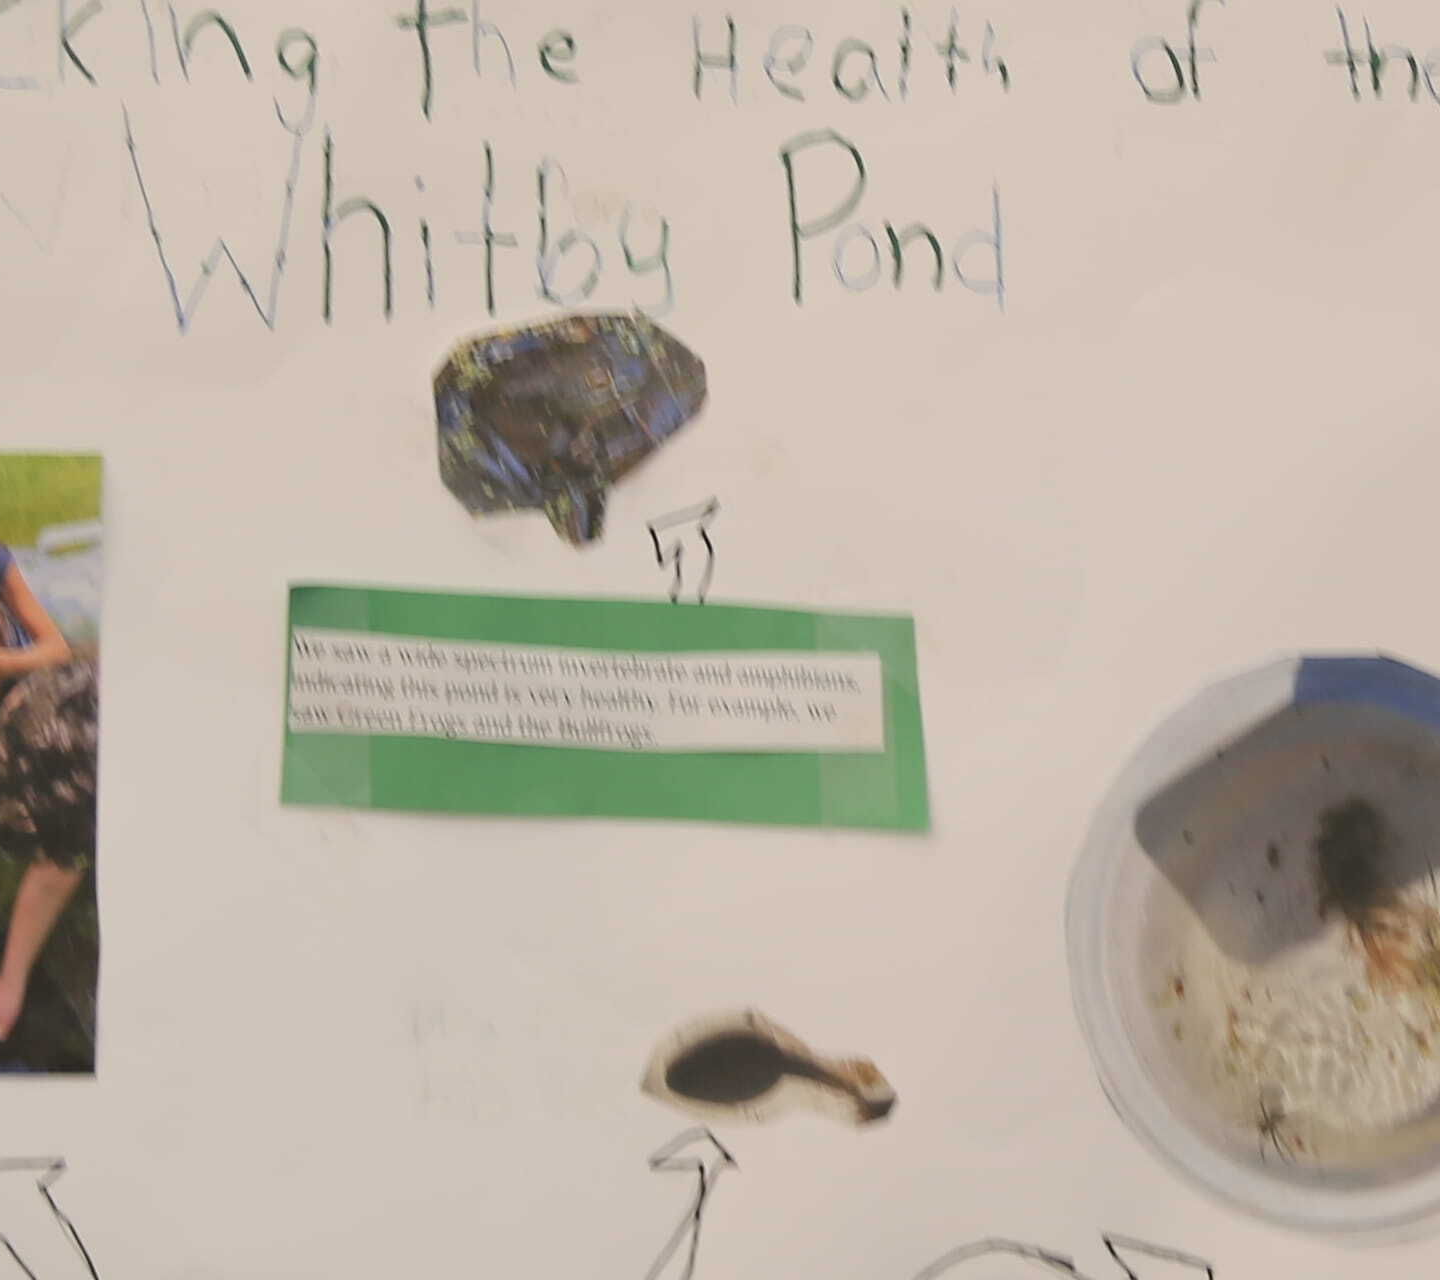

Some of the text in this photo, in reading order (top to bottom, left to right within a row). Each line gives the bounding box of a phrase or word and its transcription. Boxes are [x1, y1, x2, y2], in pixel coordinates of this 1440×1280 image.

[123, 96, 1009, 336] Whitby Pond
[293, 635, 326, 660] We
[331, 641, 370, 663] saw
[380, 646, 392, 664] a
[397, 642, 447, 668] wide
[453, 648, 553, 675] spectrum
[693, 661, 732, 686] and
[290, 703, 328, 724] saw
[336, 705, 402, 731] Green
[408, 706, 466, 740] Frogs
[472, 708, 513, 736] and
[517, 712, 553, 739] the
[291, 670, 395, 700] indicating
[400, 674, 438, 699] this
[445, 679, 499, 705] pond
[504, 685, 521, 704] is
[528, 686, 571, 708] very
[668, 688, 700, 715] For
[807, 698, 840, 723] we
